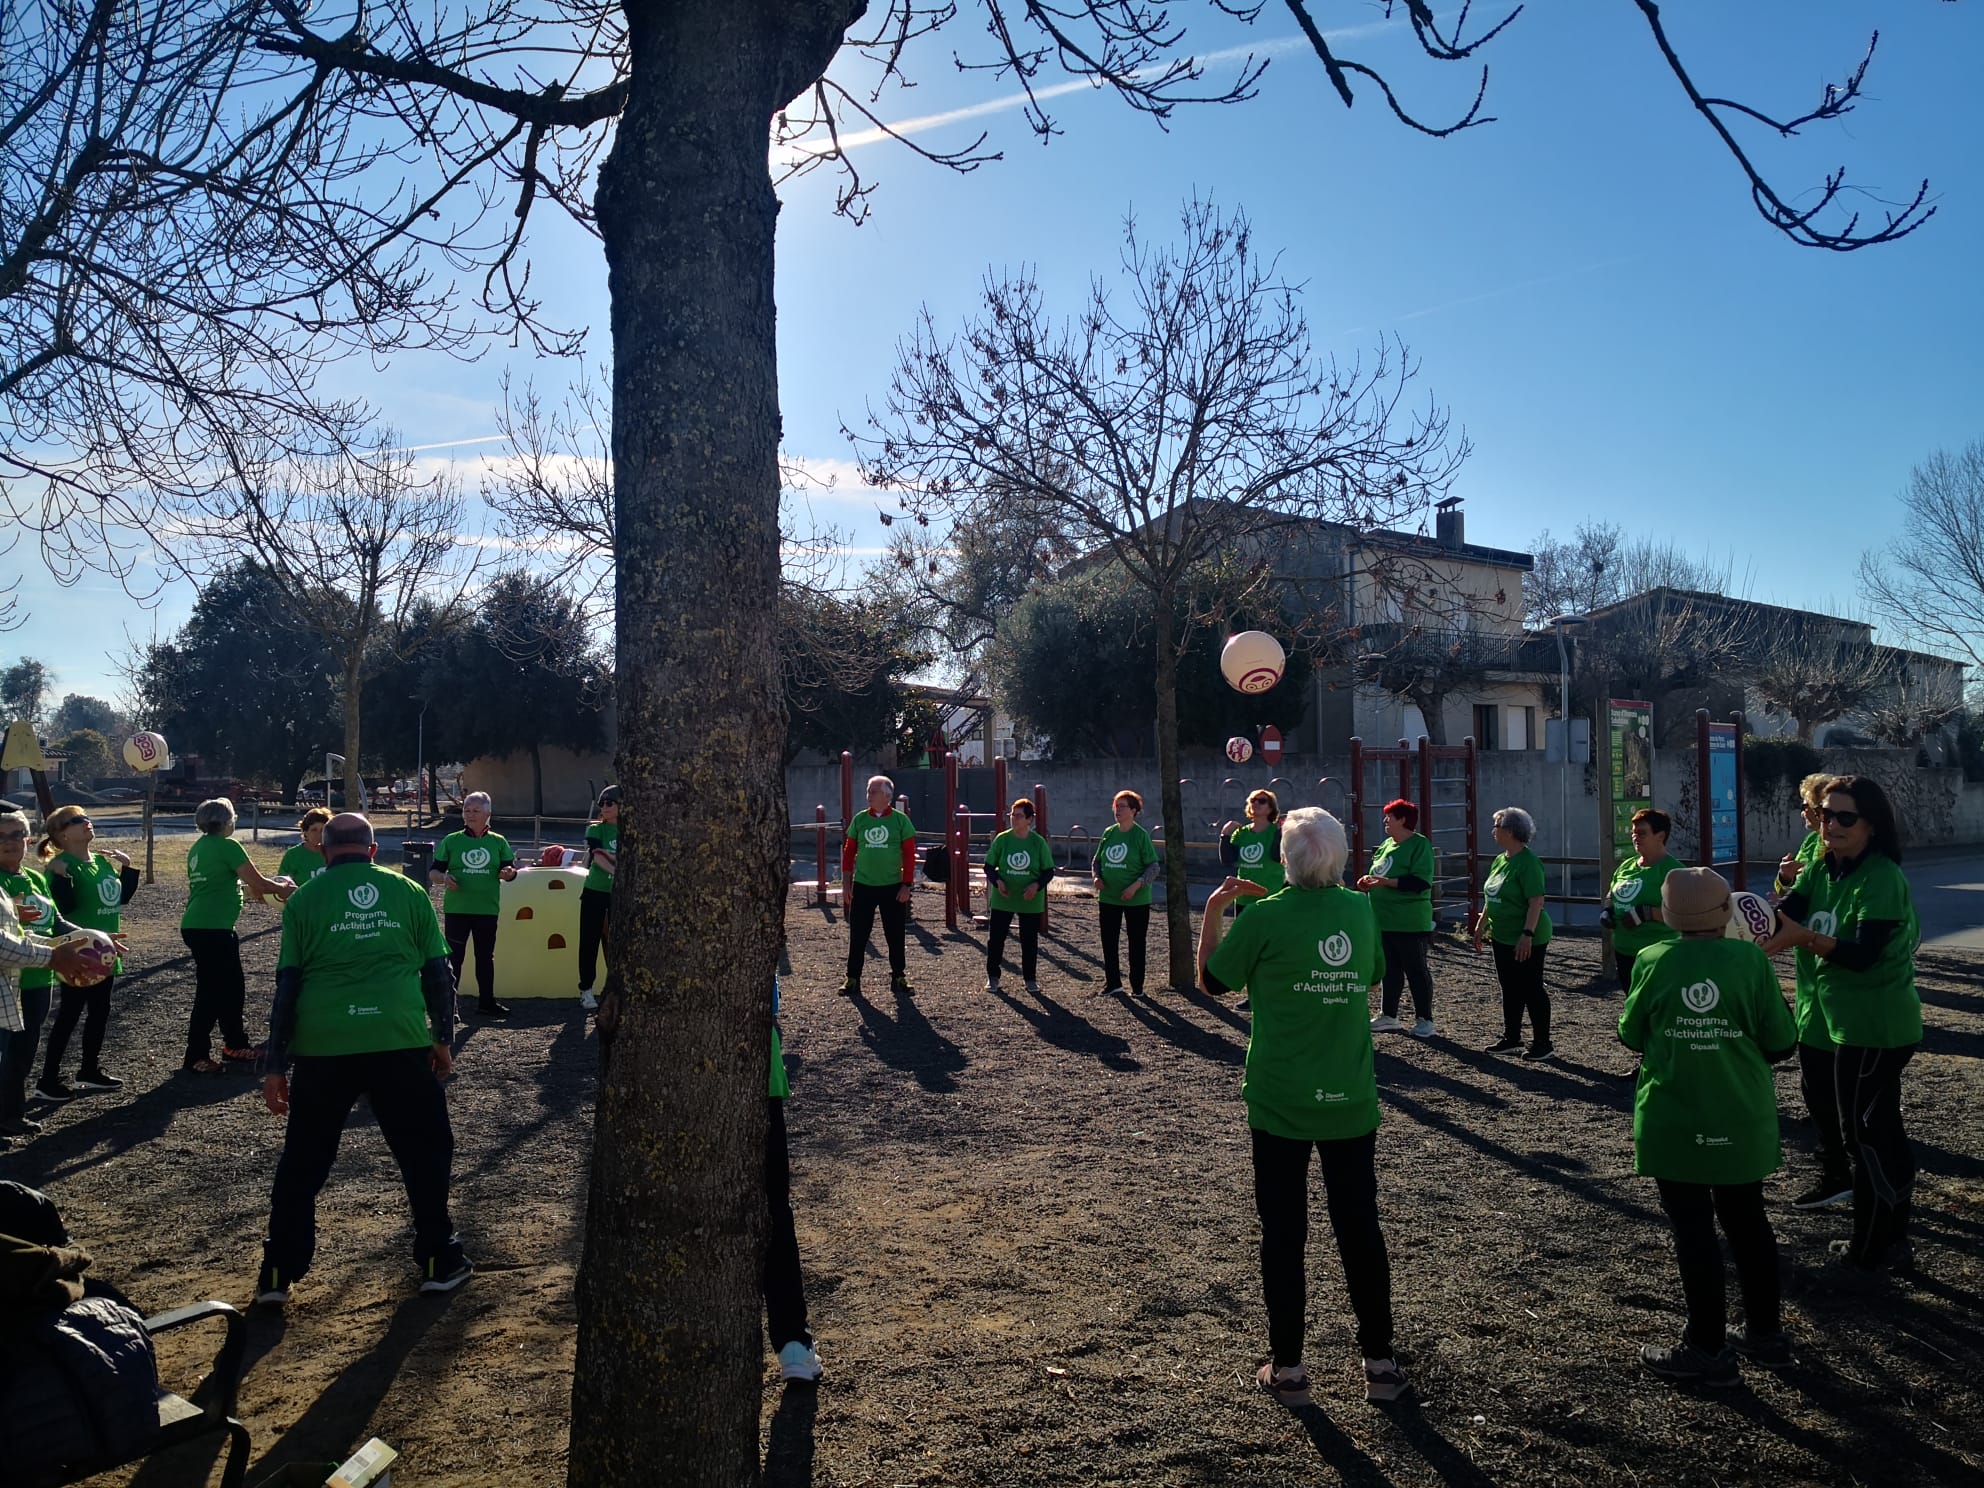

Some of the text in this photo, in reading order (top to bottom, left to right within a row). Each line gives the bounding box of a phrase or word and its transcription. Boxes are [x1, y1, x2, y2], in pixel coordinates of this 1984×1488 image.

[344, 910, 387, 921] Programa
[330, 921, 375, 932] d'Activitat
[1311, 970, 1358, 981] Programa
[1293, 982, 1343, 993] d'Activitat
[1676, 1016, 1728, 1028] Programa
[1664, 1027, 1714, 1039] d'Activitat
